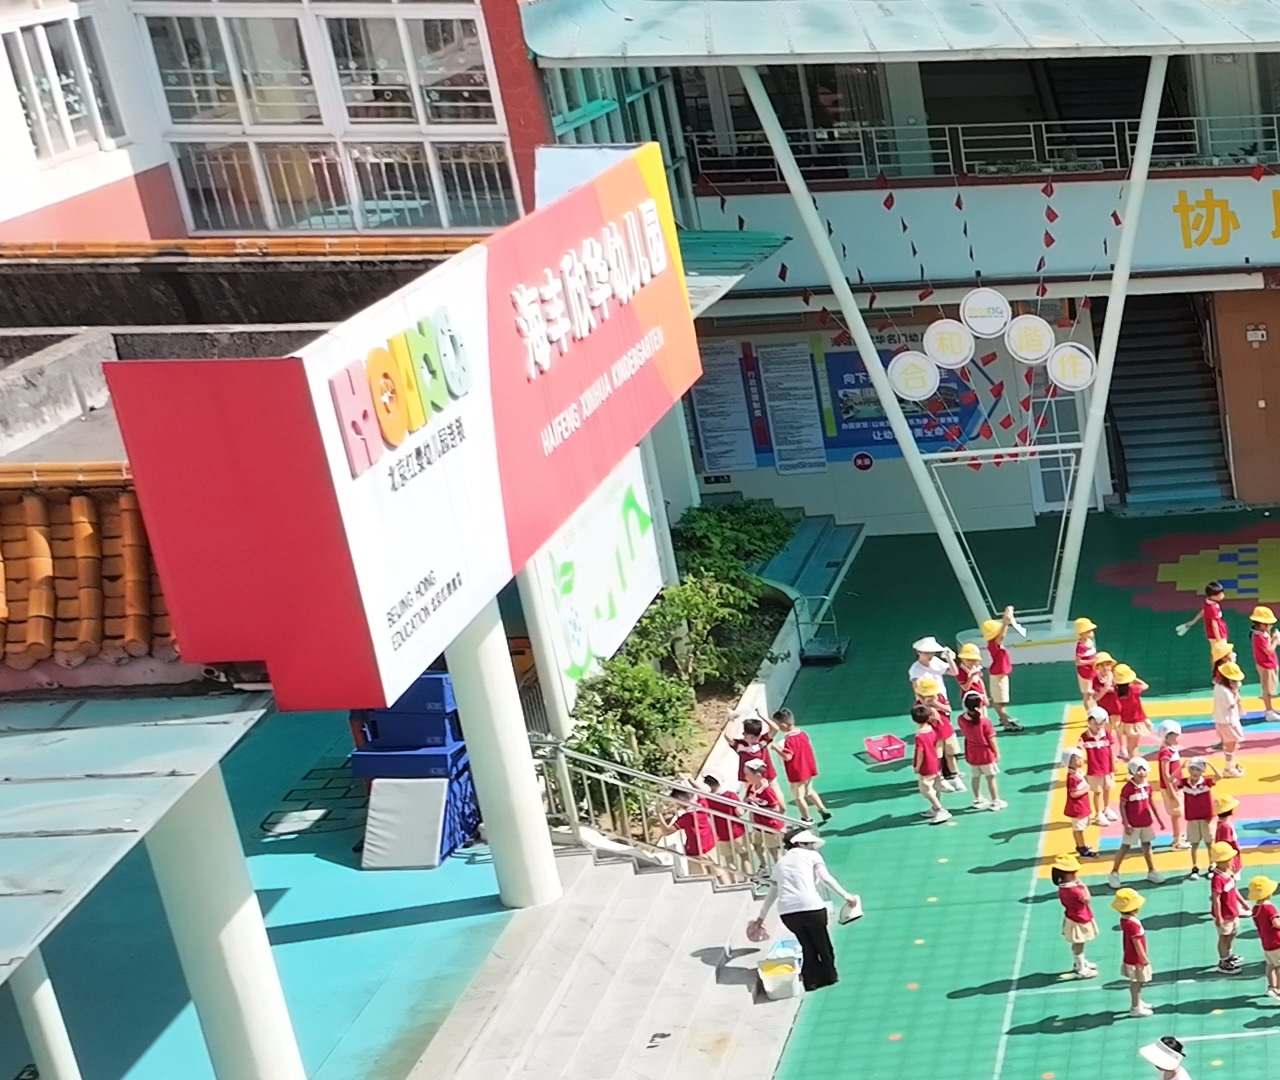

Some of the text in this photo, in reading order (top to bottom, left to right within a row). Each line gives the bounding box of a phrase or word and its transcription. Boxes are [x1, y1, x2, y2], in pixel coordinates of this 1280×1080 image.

[511, 198, 667, 382] 海丰欣华幼儿园
[936, 332, 962, 355] 和
[902, 363, 926, 389] 合
[1058, 354, 1081, 379] 作
[540, 324, 665, 457] HAIFENG XINHUA KINDERGARTEN
